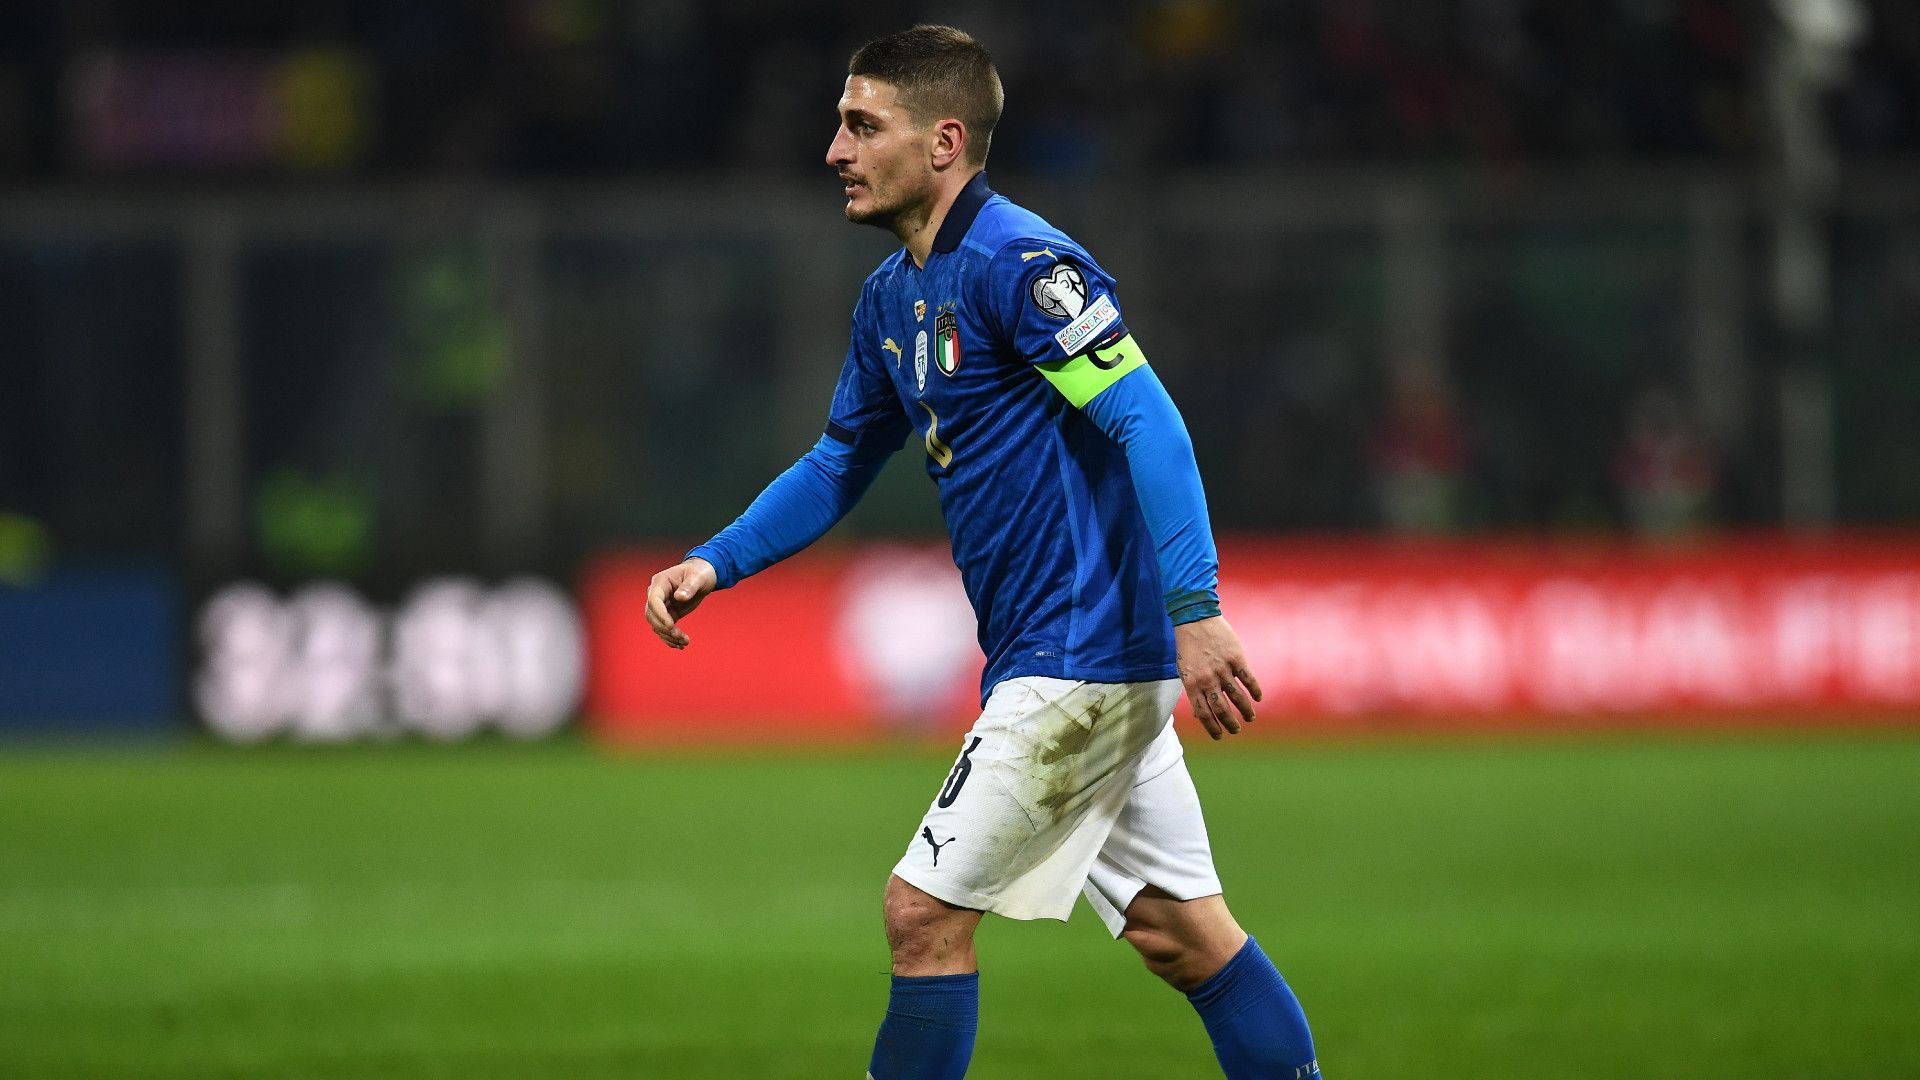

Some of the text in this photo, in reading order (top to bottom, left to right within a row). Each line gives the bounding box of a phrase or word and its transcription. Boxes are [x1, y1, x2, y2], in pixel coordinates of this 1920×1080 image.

[938, 316, 956, 330] ITALIA
[1061, 302, 1112, 348] FOUNDATION
[938, 736, 983, 809] 6
